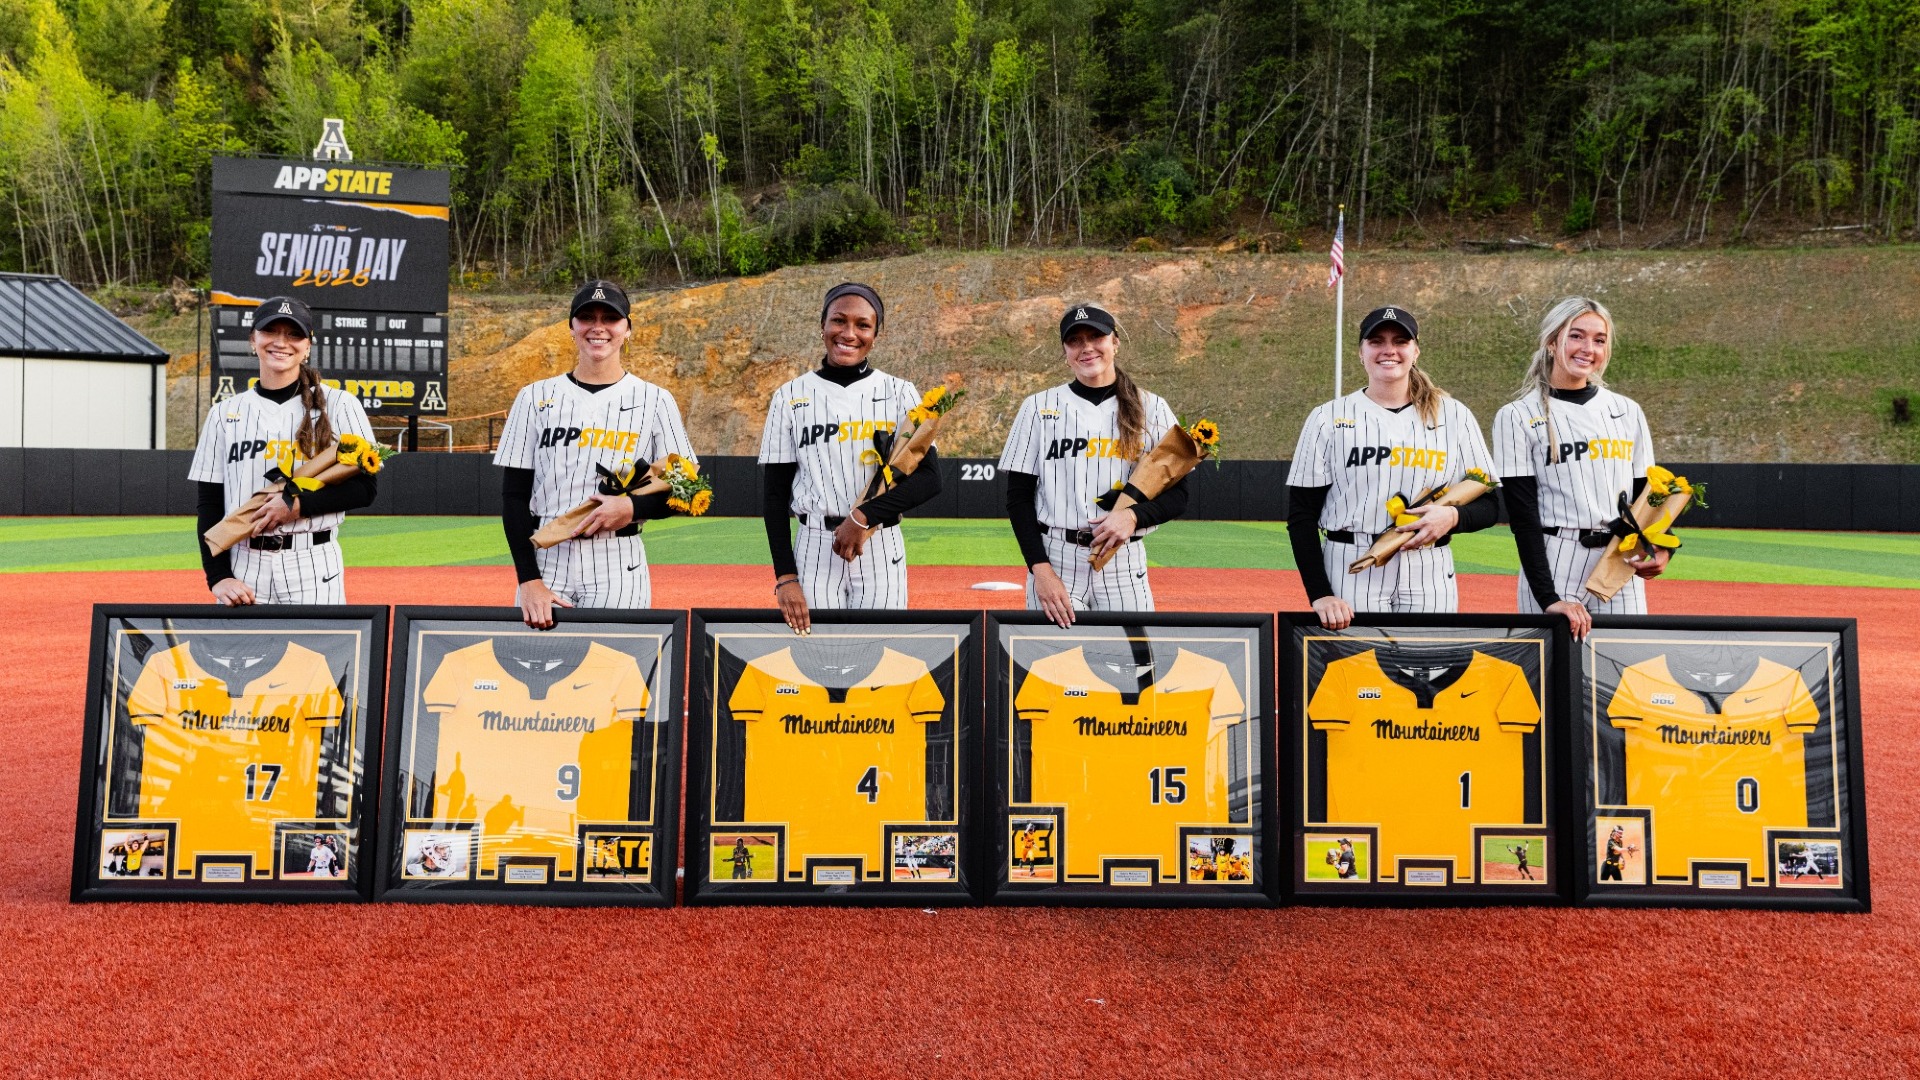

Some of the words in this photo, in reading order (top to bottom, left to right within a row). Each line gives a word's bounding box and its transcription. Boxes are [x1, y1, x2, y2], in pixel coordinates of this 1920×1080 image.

[256, 232, 352, 279] SENIOR
[355, 237, 407, 281] DAY
[292, 268, 371, 288] 2026
[244, 311, 254, 319] AT
[335, 317, 368, 328] STRIKE
[388, 319, 406, 330] OUT
[323, 336, 330, 345] 5
[336, 336, 343, 345] 6
[348, 337, 355, 345] 7
[360, 337, 367, 346] 8
[373, 337, 379, 346] 9
[383, 338, 393, 347] 10
[394, 338, 413, 347] RUNS
[414, 339, 430, 348] HITS
[430, 340, 444, 348] ERR
[344, 379, 415, 398] BYERS
[961, 464, 996, 481] 220
[178, 709, 290, 733] Mountaineers
[478, 710, 595, 733] Mountaineers
[780, 712, 895, 735] Mountaineers
[1073, 715, 1188, 736] Mountaineers
[1371, 718, 1480, 742] Mountaineers
[1656, 724, 1771, 746] Mountaineers
[244, 763, 282, 802] 17
[557, 763, 581, 802] 9
[856, 766, 879, 804] 4
[1149, 766, 1188, 805] 15
[1458, 770, 1471, 809] 1
[1736, 776, 1760, 814] 0
